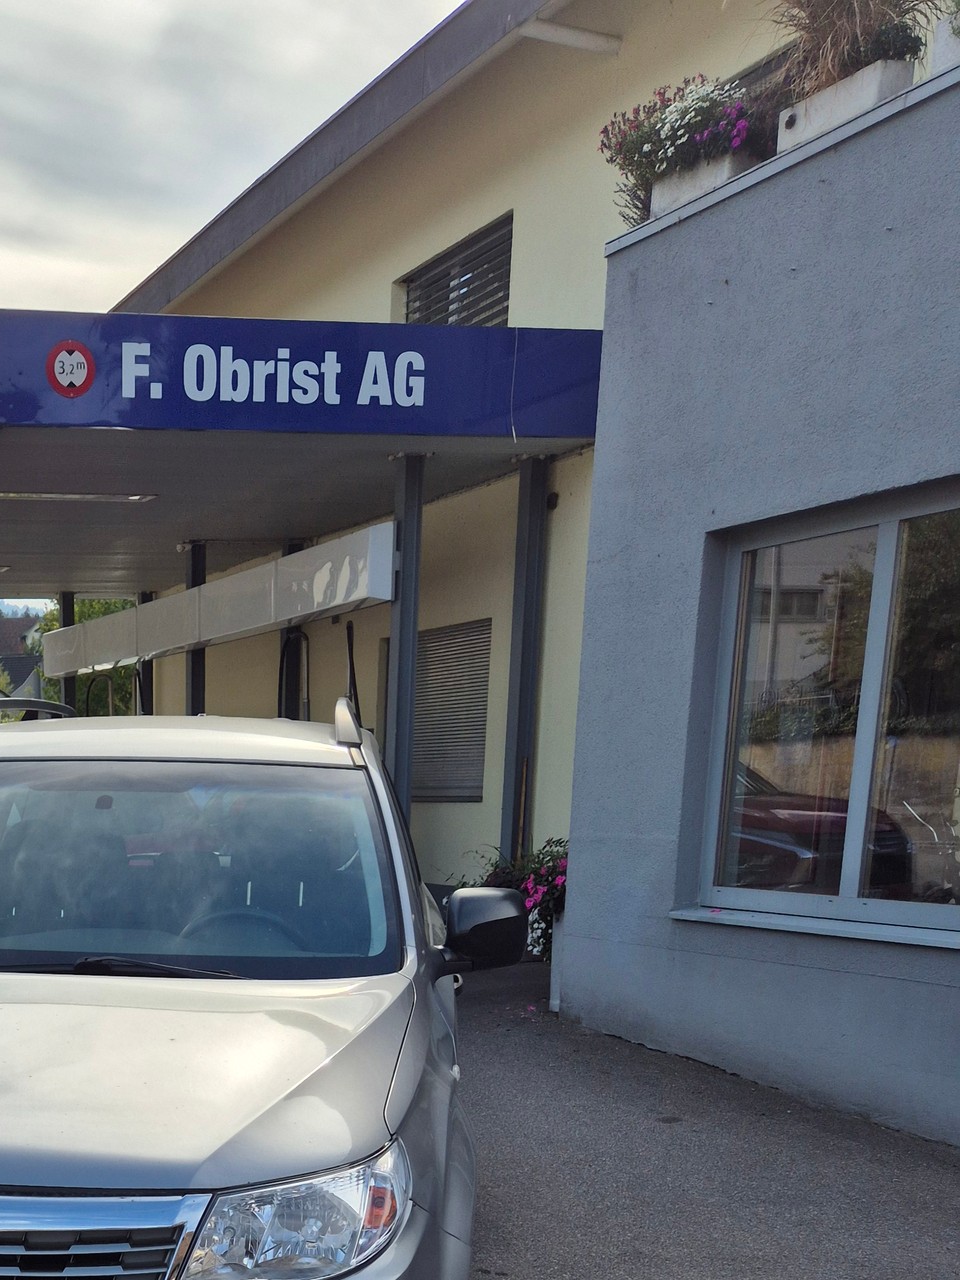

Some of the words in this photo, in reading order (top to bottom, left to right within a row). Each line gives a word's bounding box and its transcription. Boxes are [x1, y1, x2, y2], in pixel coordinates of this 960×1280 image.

[121, 342, 162, 399] F.
[183, 343, 341, 405] Obrist
[356, 351, 425, 407] AG
